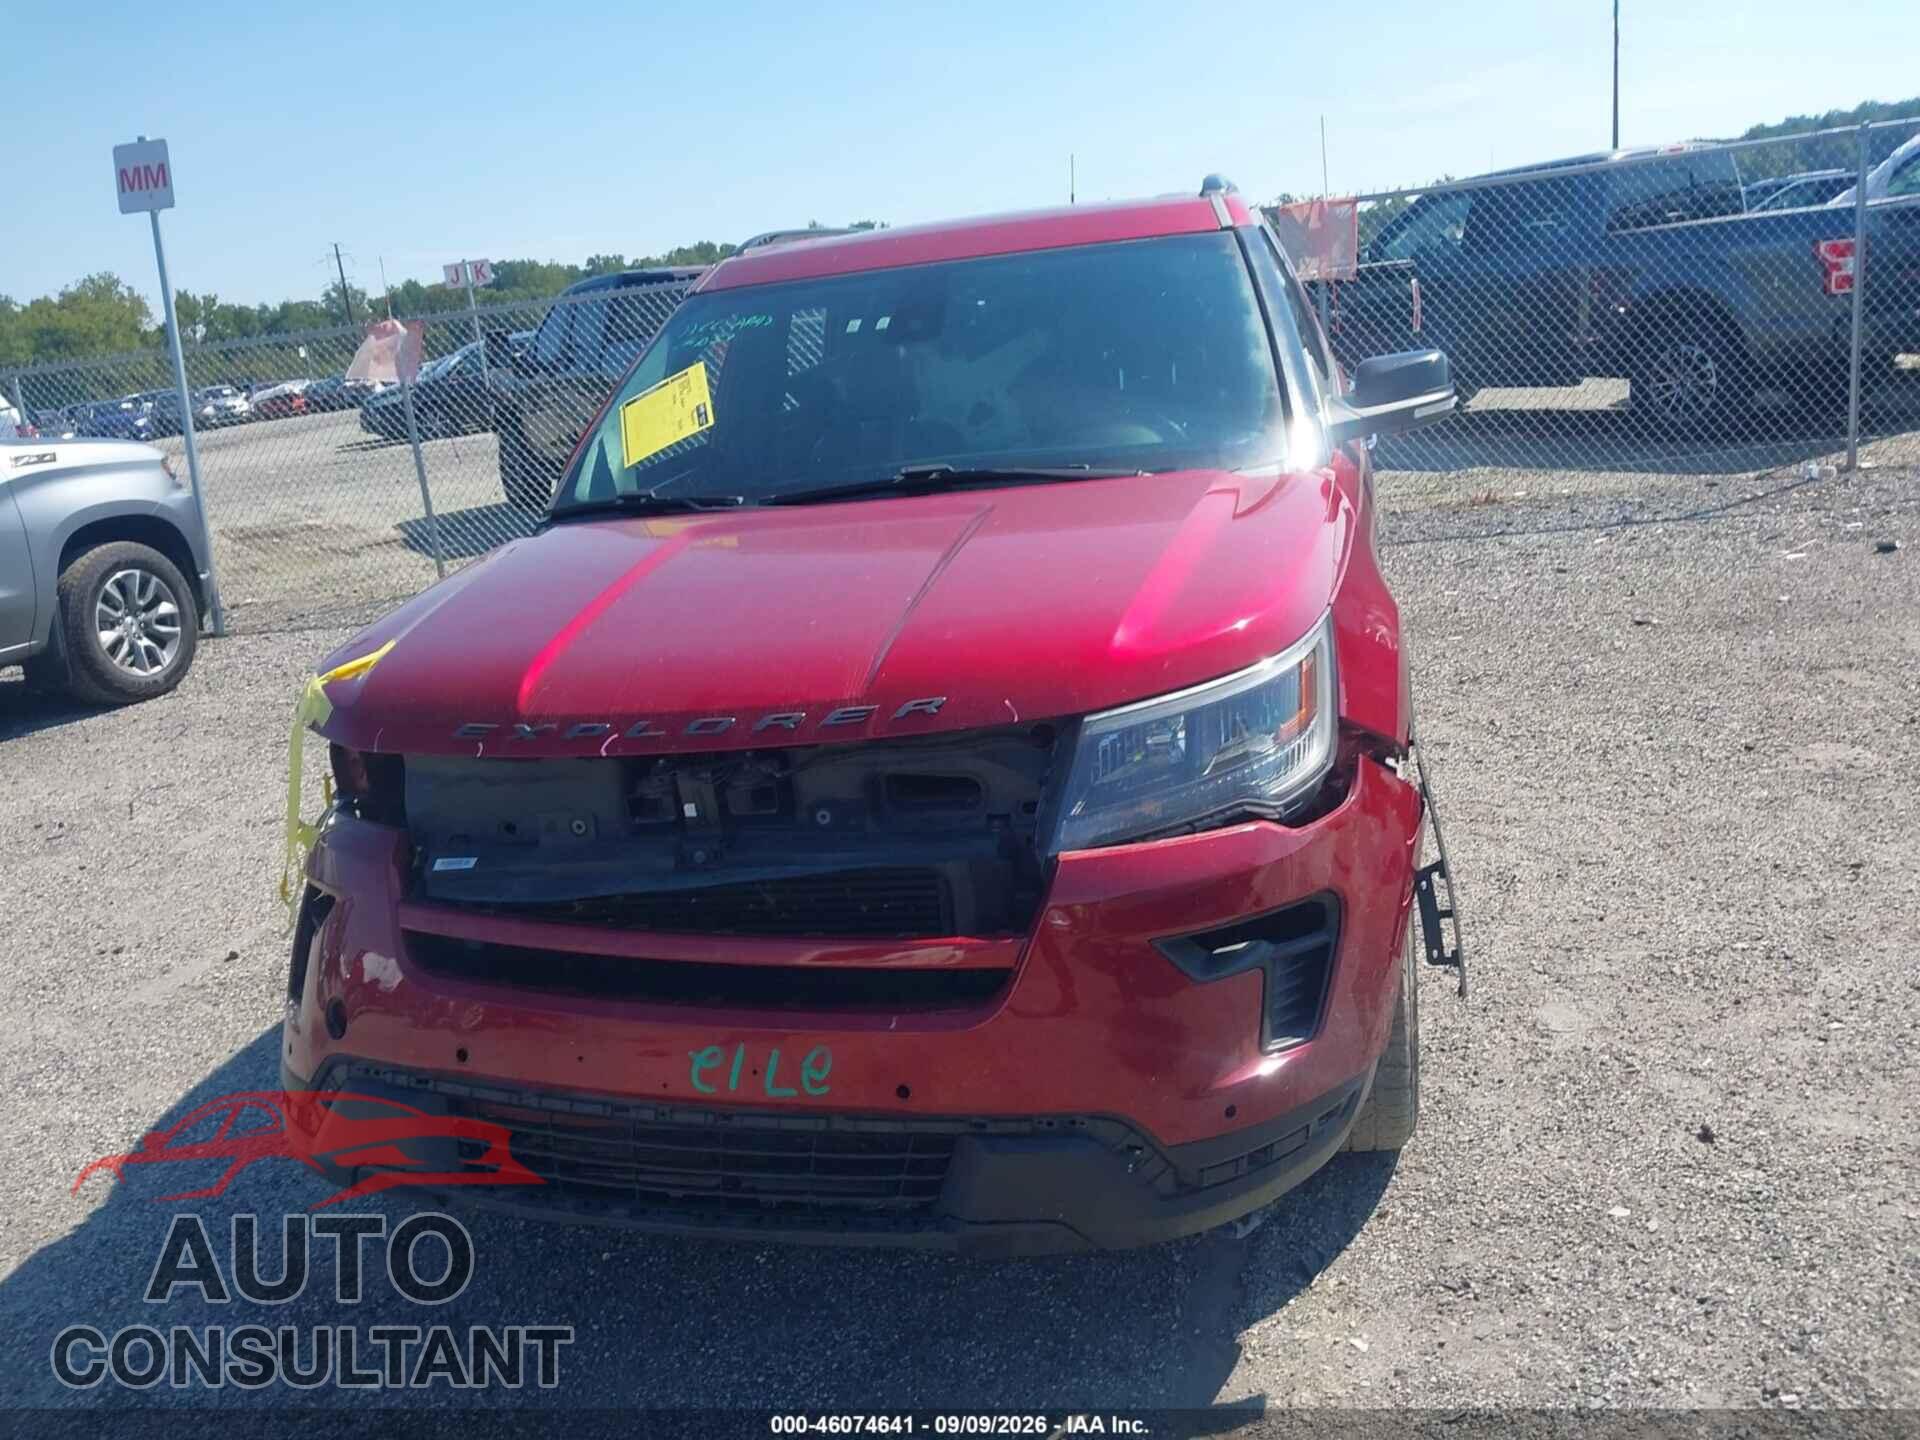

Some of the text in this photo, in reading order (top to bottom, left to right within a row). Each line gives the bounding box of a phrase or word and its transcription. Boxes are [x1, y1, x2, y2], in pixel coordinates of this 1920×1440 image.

[118, 162, 169, 194] MM
[451, 265, 460, 284] J
[474, 263, 488, 281] K
[451, 696, 947, 741] EXPLORER
